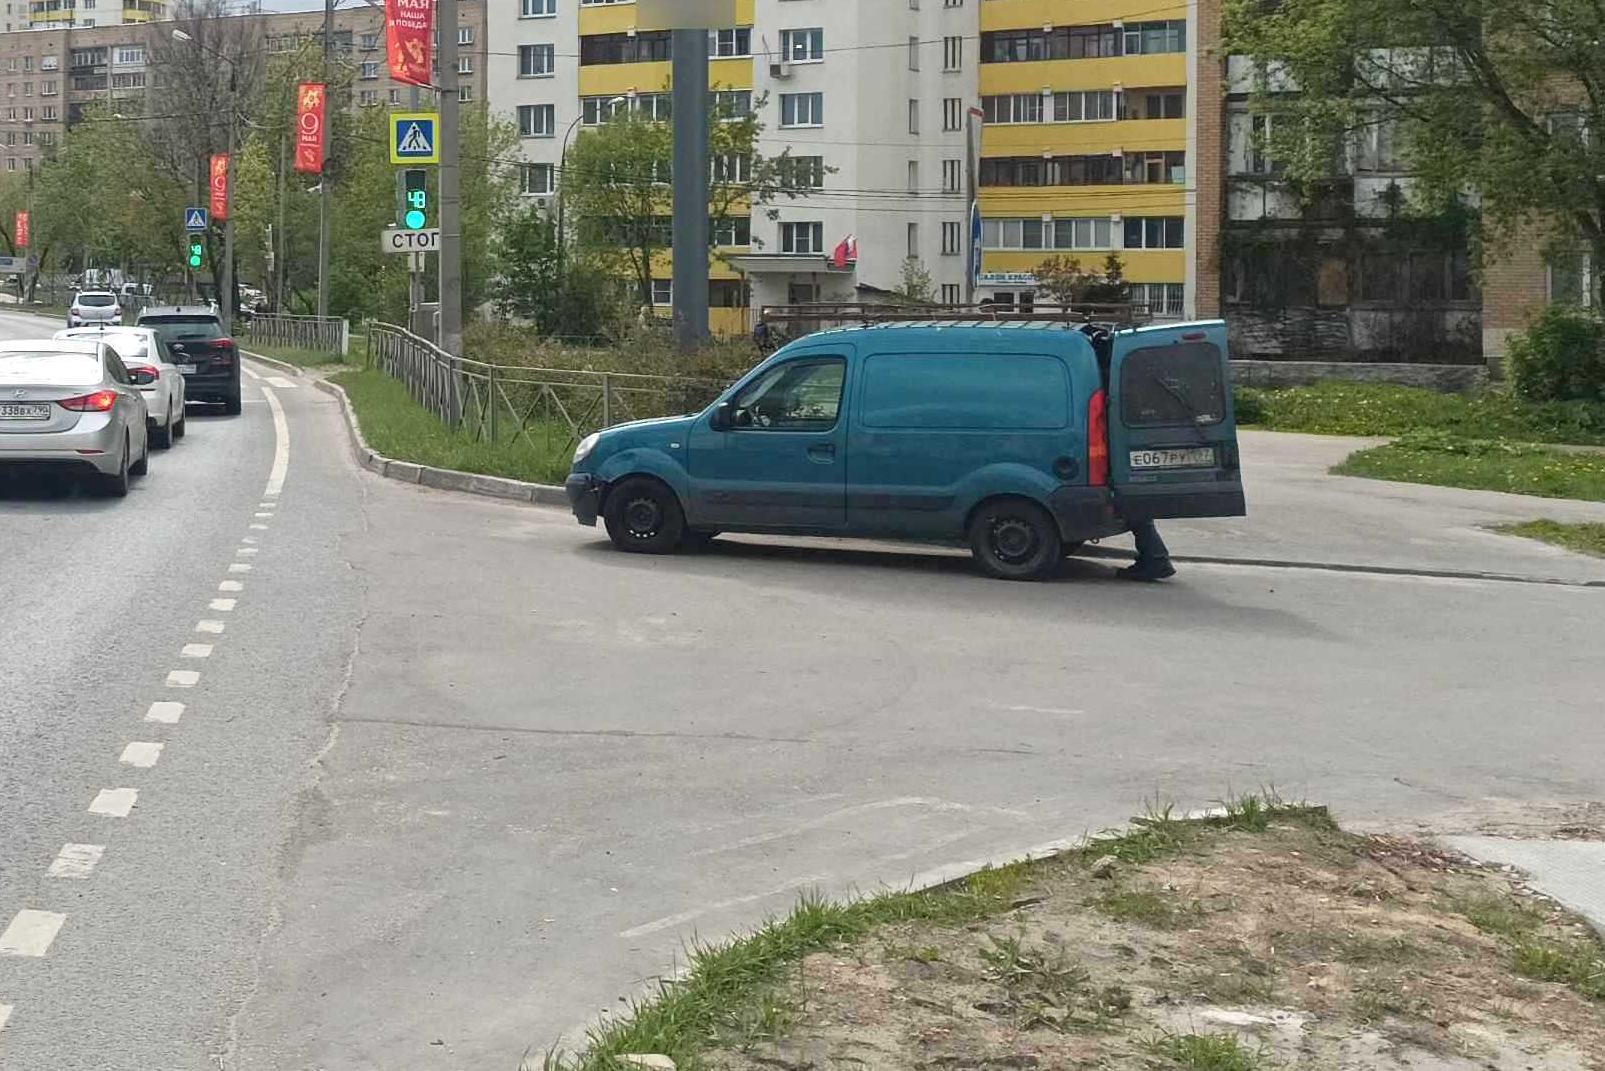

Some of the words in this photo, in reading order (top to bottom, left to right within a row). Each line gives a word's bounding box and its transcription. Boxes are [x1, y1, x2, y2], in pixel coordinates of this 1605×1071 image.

[400, 10, 426, 20] НАША
[301, 113, 319, 135] 9
[407, 190, 425, 209] 48
